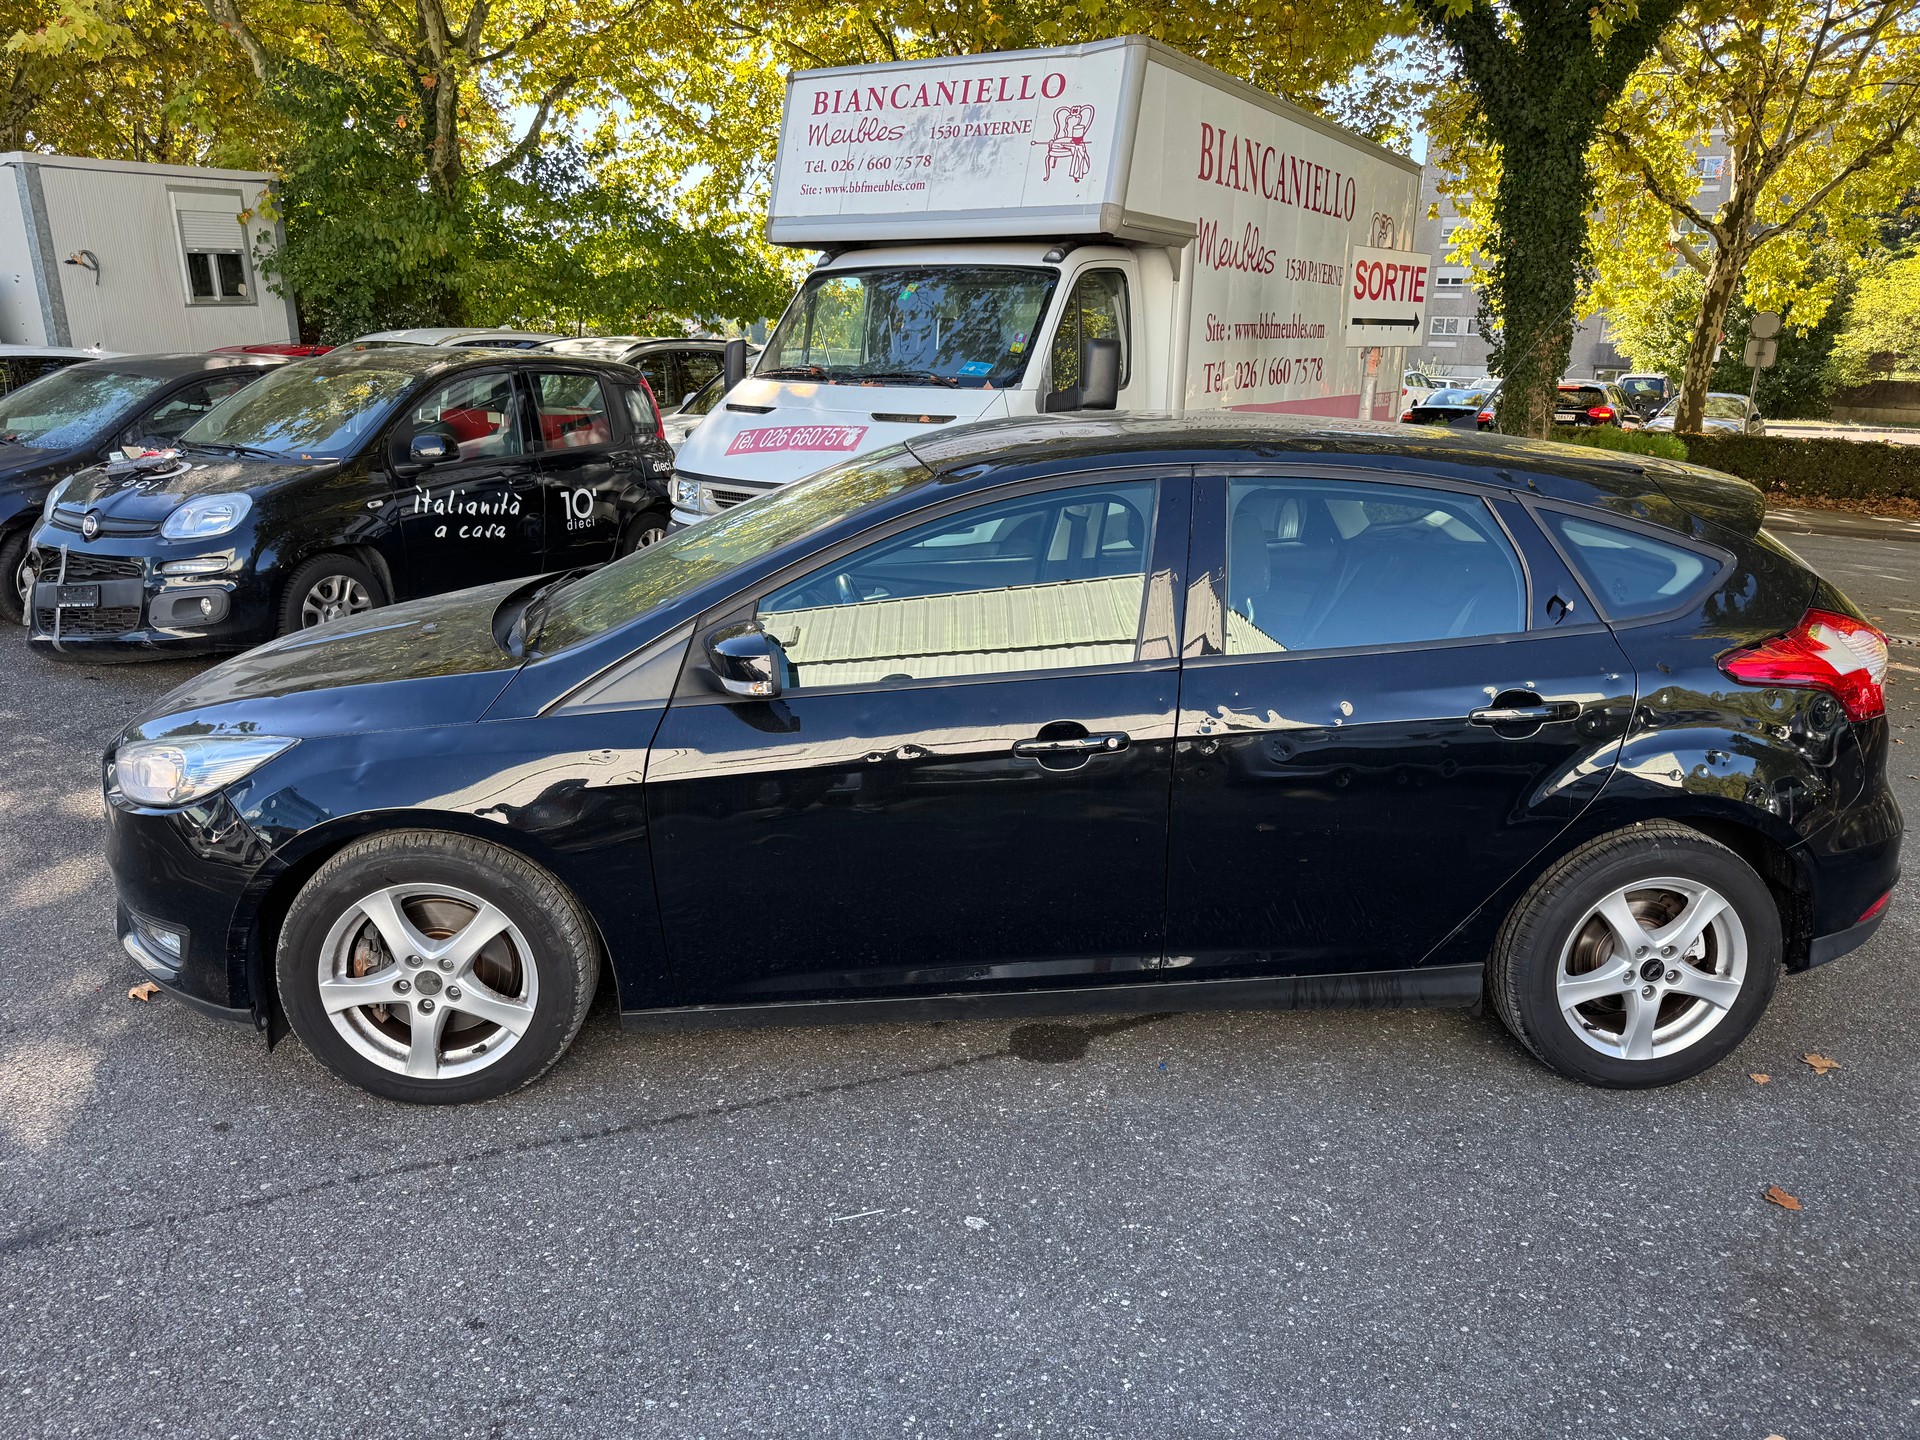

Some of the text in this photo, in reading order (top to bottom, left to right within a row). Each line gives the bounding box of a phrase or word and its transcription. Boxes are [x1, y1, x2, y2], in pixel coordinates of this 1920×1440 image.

[811, 72, 1067, 116] BIANCANIELLO
[808, 116, 1033, 147] Meubles 1530 PAYERNE
[804, 160, 827, 174] Tél.
[831, 156, 856, 172] 026
[866, 155, 892, 171] 660
[894, 154, 932, 171] 7578
[1198, 121, 1356, 222] BIANCANIELLO
[799, 183, 817, 196] Site
[825, 179, 926, 195] www.bbfmeubles.com
[1198, 216, 1345, 287] Meubles 1530 PAYERNE
[1353, 259, 1427, 303] SORTIE
[1205, 313, 1225, 342] Site
[1234, 312, 1325, 341] www.bbfmeubles.com
[1234, 358, 1258, 390] 026
[1268, 356, 1292, 386] 660
[1293, 357, 1324, 386] 7578
[733, 430, 759, 450] Tel.
[759, 428, 790, 448] 026
[434, 522, 507, 539] a casa
[566, 517, 596, 531] dieci
